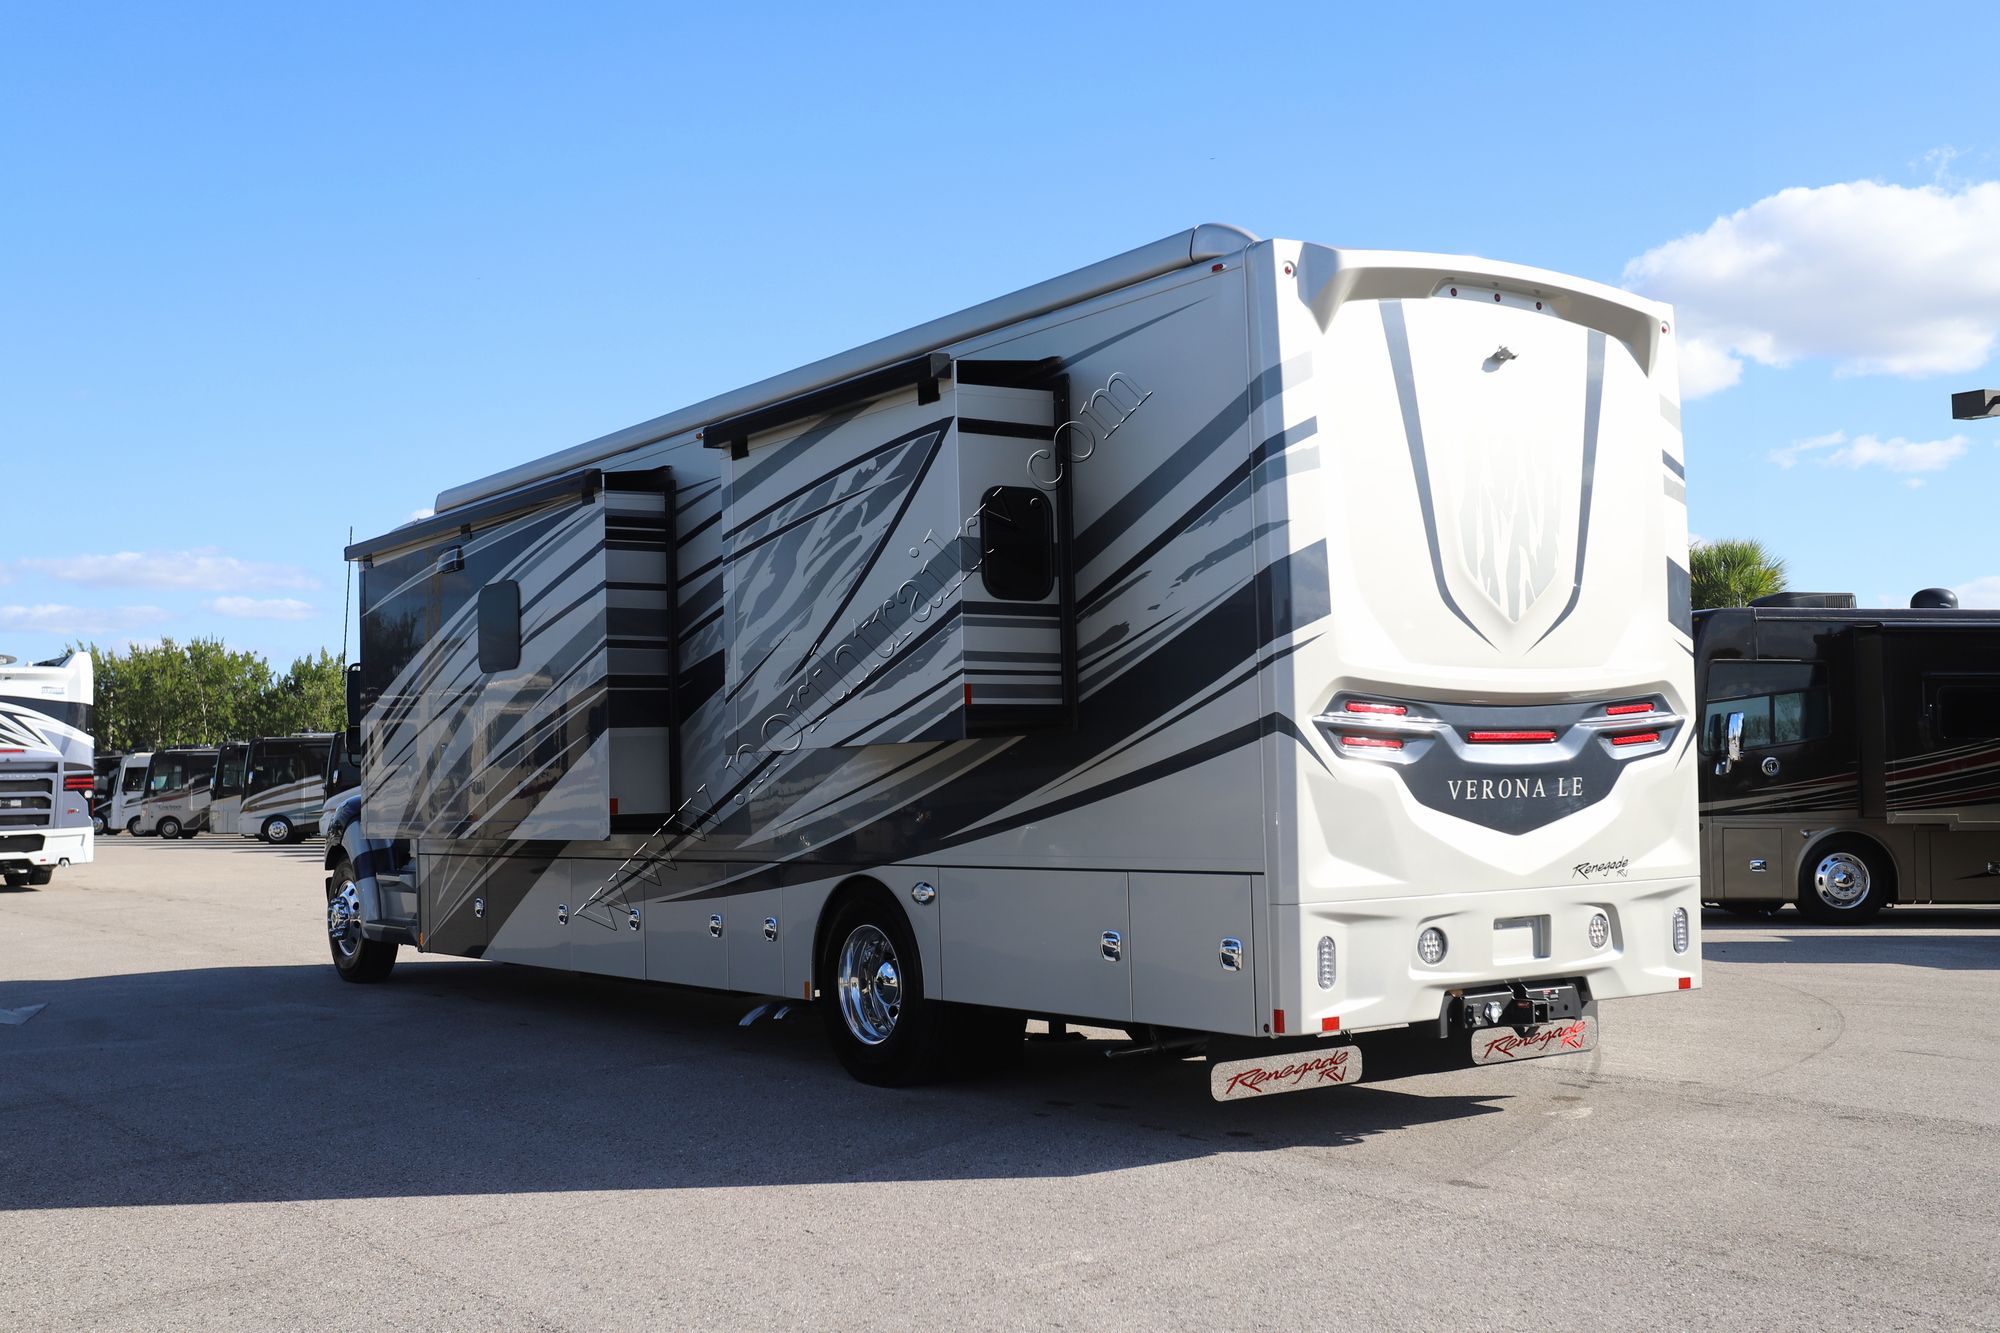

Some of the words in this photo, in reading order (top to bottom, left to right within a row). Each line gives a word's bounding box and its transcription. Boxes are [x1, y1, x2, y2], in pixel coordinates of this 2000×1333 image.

[1447, 778, 1547, 801] VERONA
[1557, 776, 1584, 798] LE
[1571, 855, 1629, 880] Renegade
[1483, 1020, 1586, 1059] Renegade
[1560, 1034, 1585, 1049] RV
[1225, 1049, 1349, 1095] Renegade
[1317, 1065, 1347, 1083] RV
